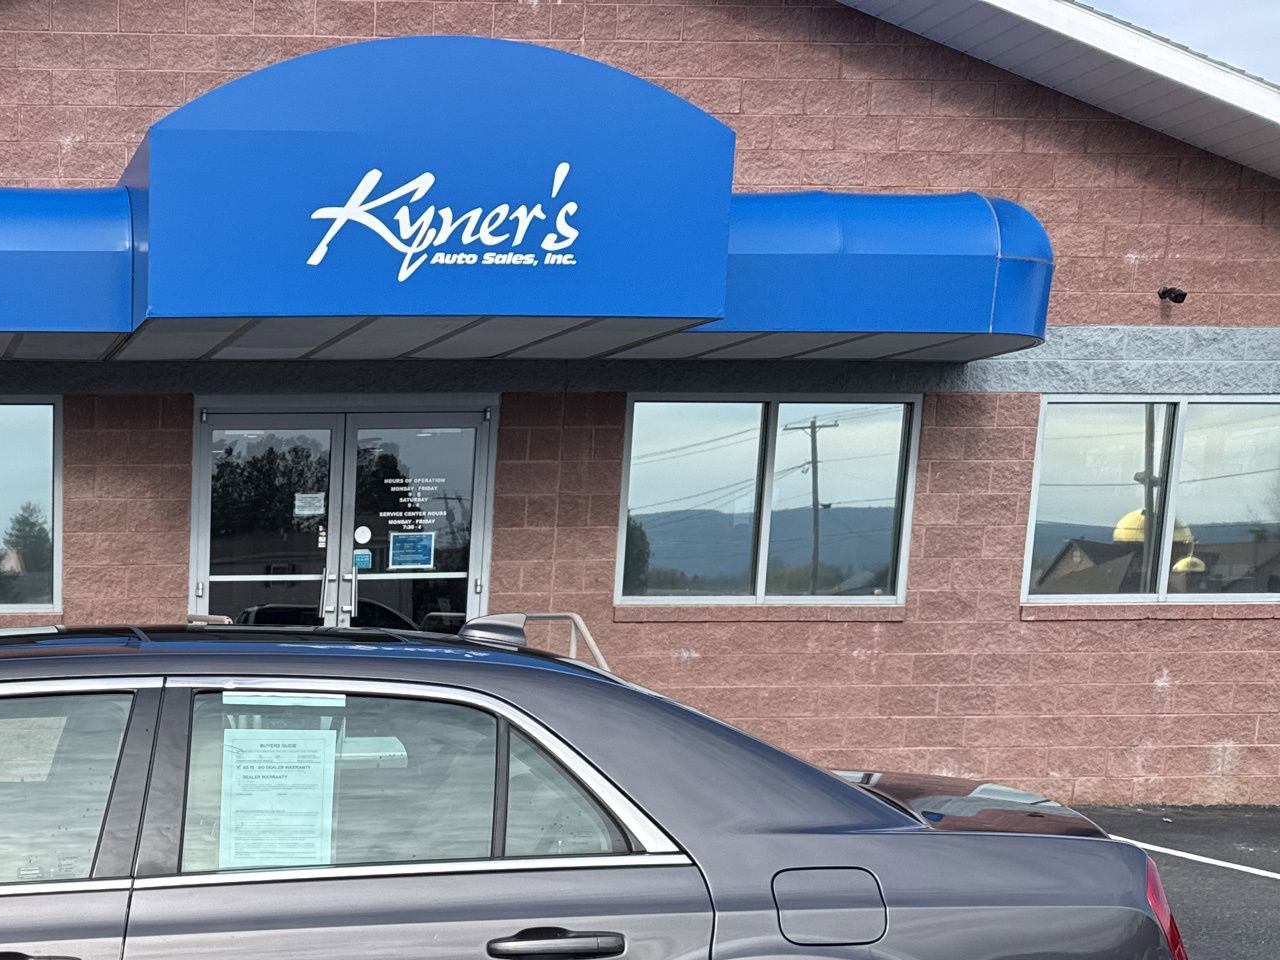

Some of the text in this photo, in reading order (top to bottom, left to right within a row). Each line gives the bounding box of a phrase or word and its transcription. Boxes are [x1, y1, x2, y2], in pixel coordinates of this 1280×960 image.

[306, 161, 580, 283] Kyner's
[430, 252, 577, 267] Auto Sales, Inc.
